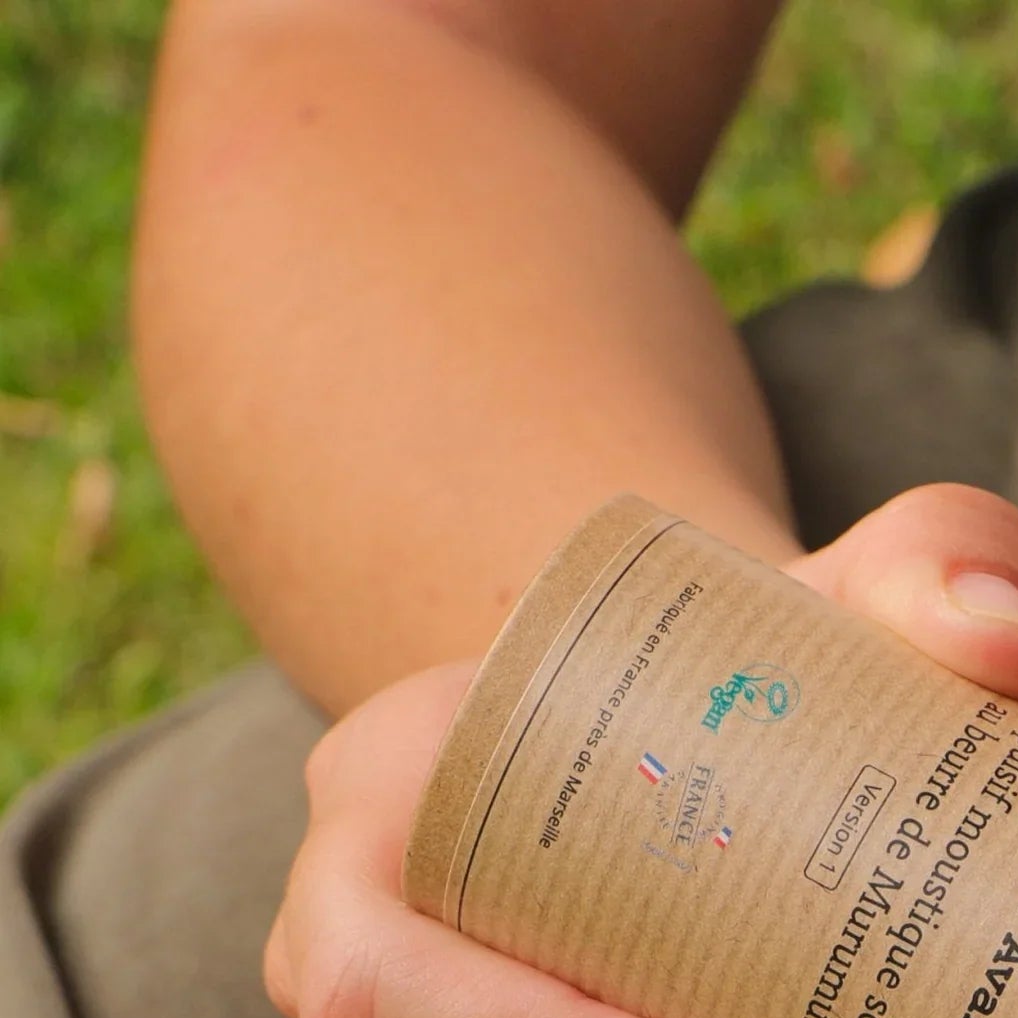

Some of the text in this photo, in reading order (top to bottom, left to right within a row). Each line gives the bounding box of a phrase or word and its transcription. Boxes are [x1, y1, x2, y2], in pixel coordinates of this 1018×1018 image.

[538, 581, 704, 849] Fabriqué en France près de Marseille
[701, 672, 753, 735] Vegan
[976, 702, 1008, 726] au
[674, 766, 711, 846] FRANCE
[916, 724, 1000, 811] beurre
[818, 783, 883, 876] Version 1
[886, 818, 931, 861] de
[876, 805, 992, 990] moustique
